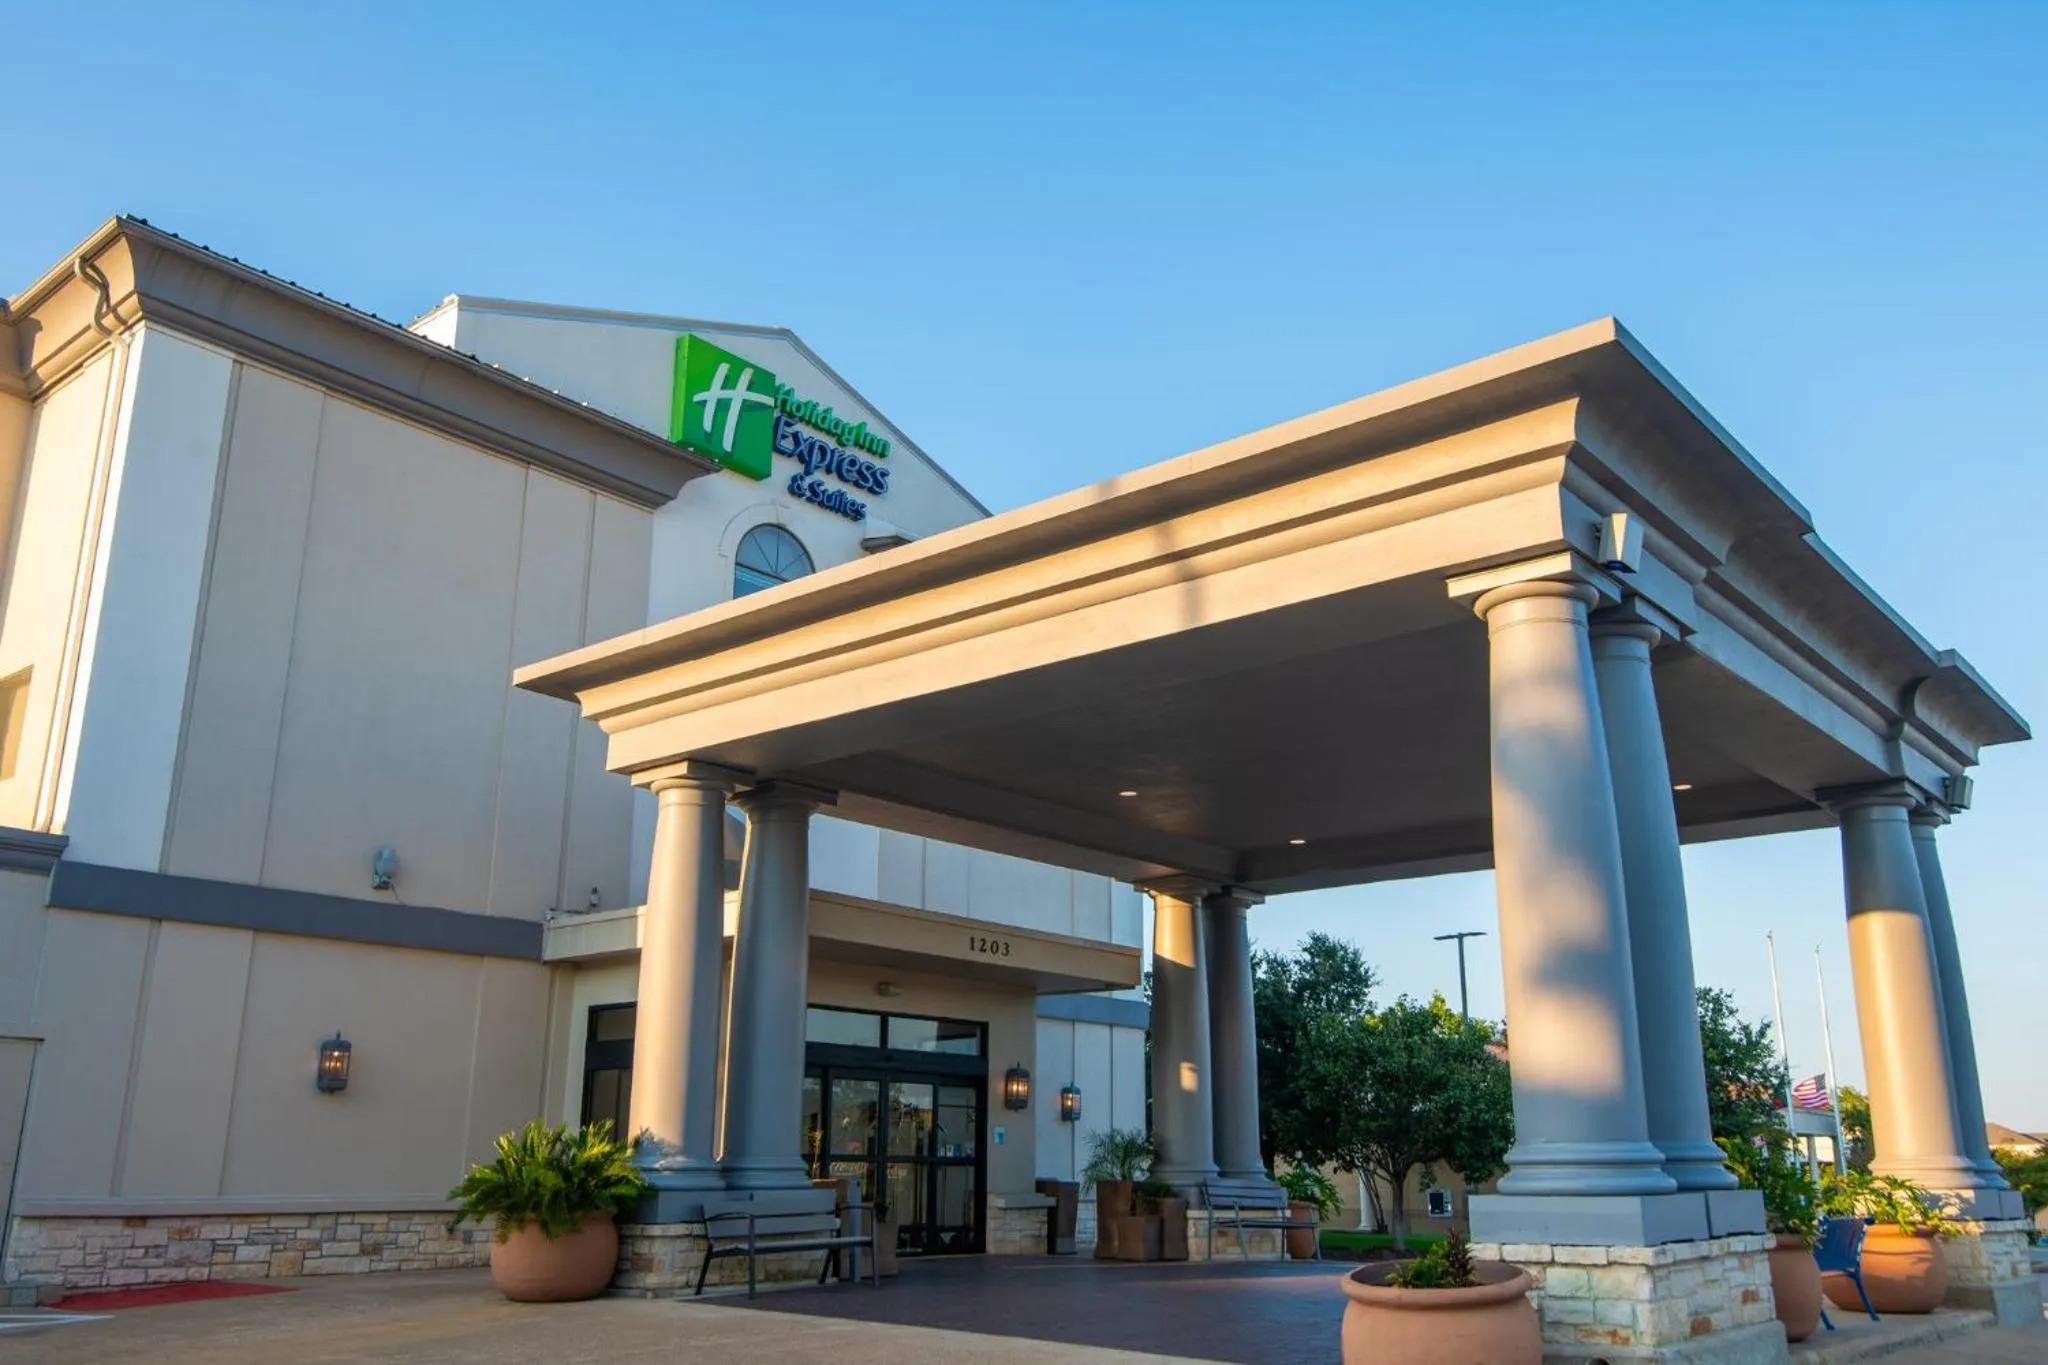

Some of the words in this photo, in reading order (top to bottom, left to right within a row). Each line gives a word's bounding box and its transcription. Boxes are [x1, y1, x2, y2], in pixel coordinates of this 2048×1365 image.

[774, 415, 890, 495] Express
[776, 383, 855, 446] Holiday
[854, 421, 891, 458] Inn
[970, 936, 1010, 957] 1203
